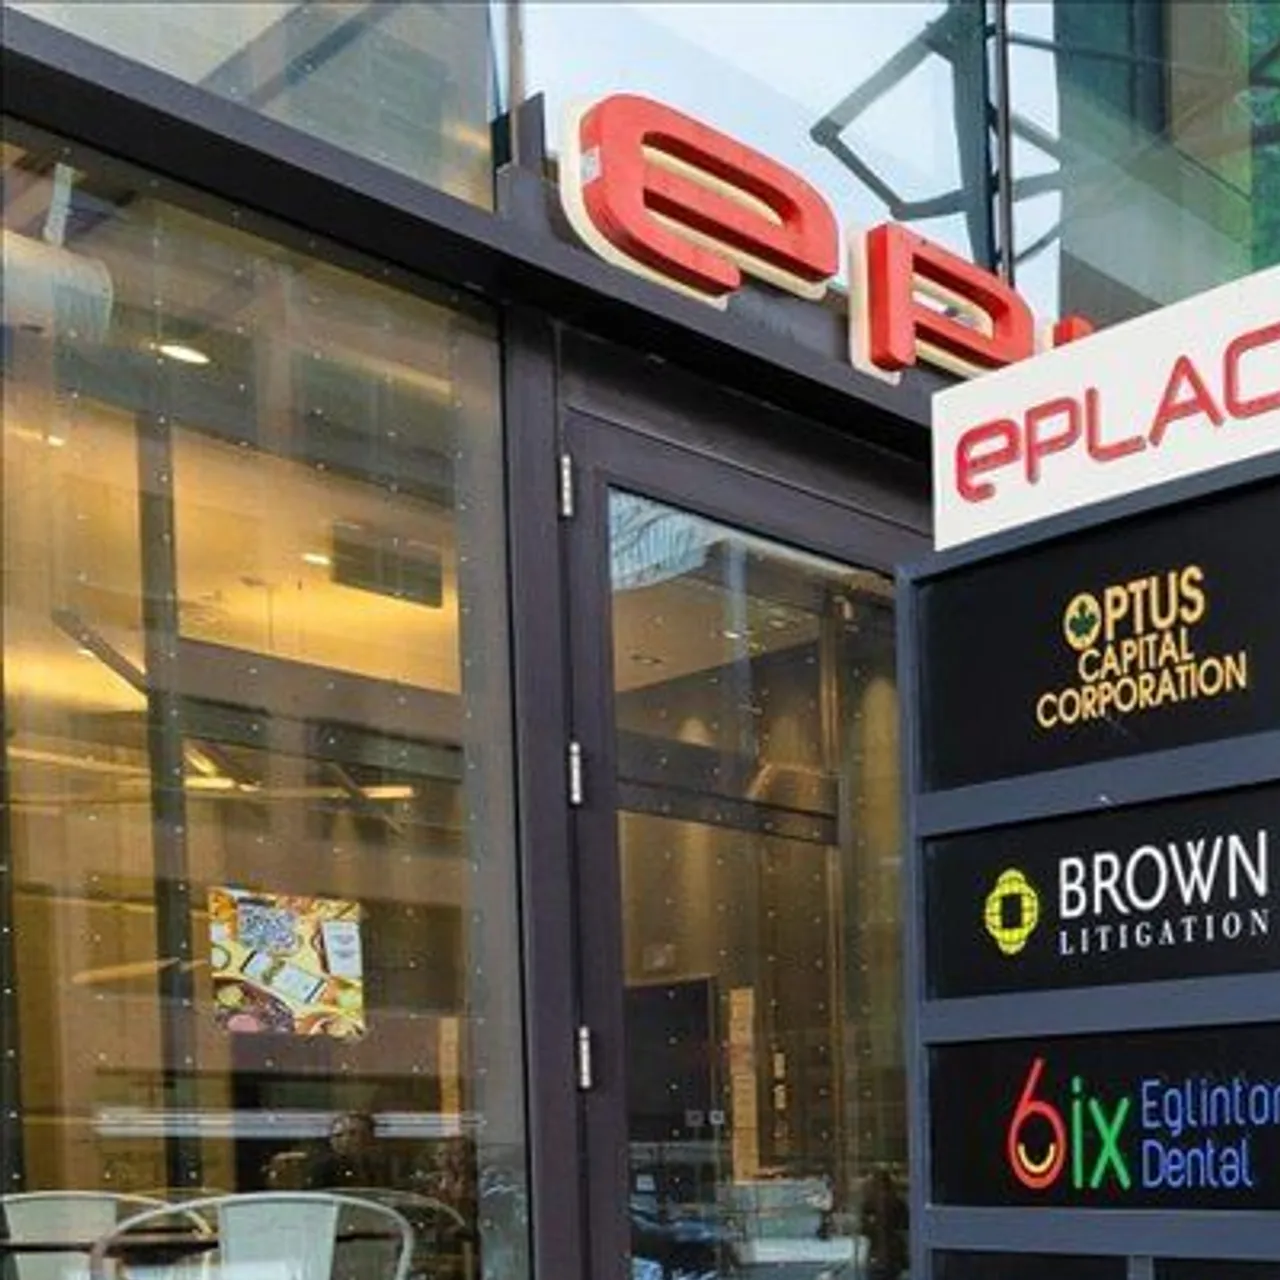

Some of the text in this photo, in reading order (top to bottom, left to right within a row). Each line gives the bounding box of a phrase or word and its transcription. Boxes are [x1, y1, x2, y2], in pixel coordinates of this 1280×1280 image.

[1064, 565, 1205, 650] OPTUS
[1036, 651, 1247, 728] CORPORATION
[1078, 627, 1195, 682] CAPITAL
[1058, 829, 1269, 919] BROWN
[1060, 908, 1270, 955] LITIGATION
[1007, 1058, 1131, 1190] 6ix
[1141, 1139, 1254, 1189] Dental
